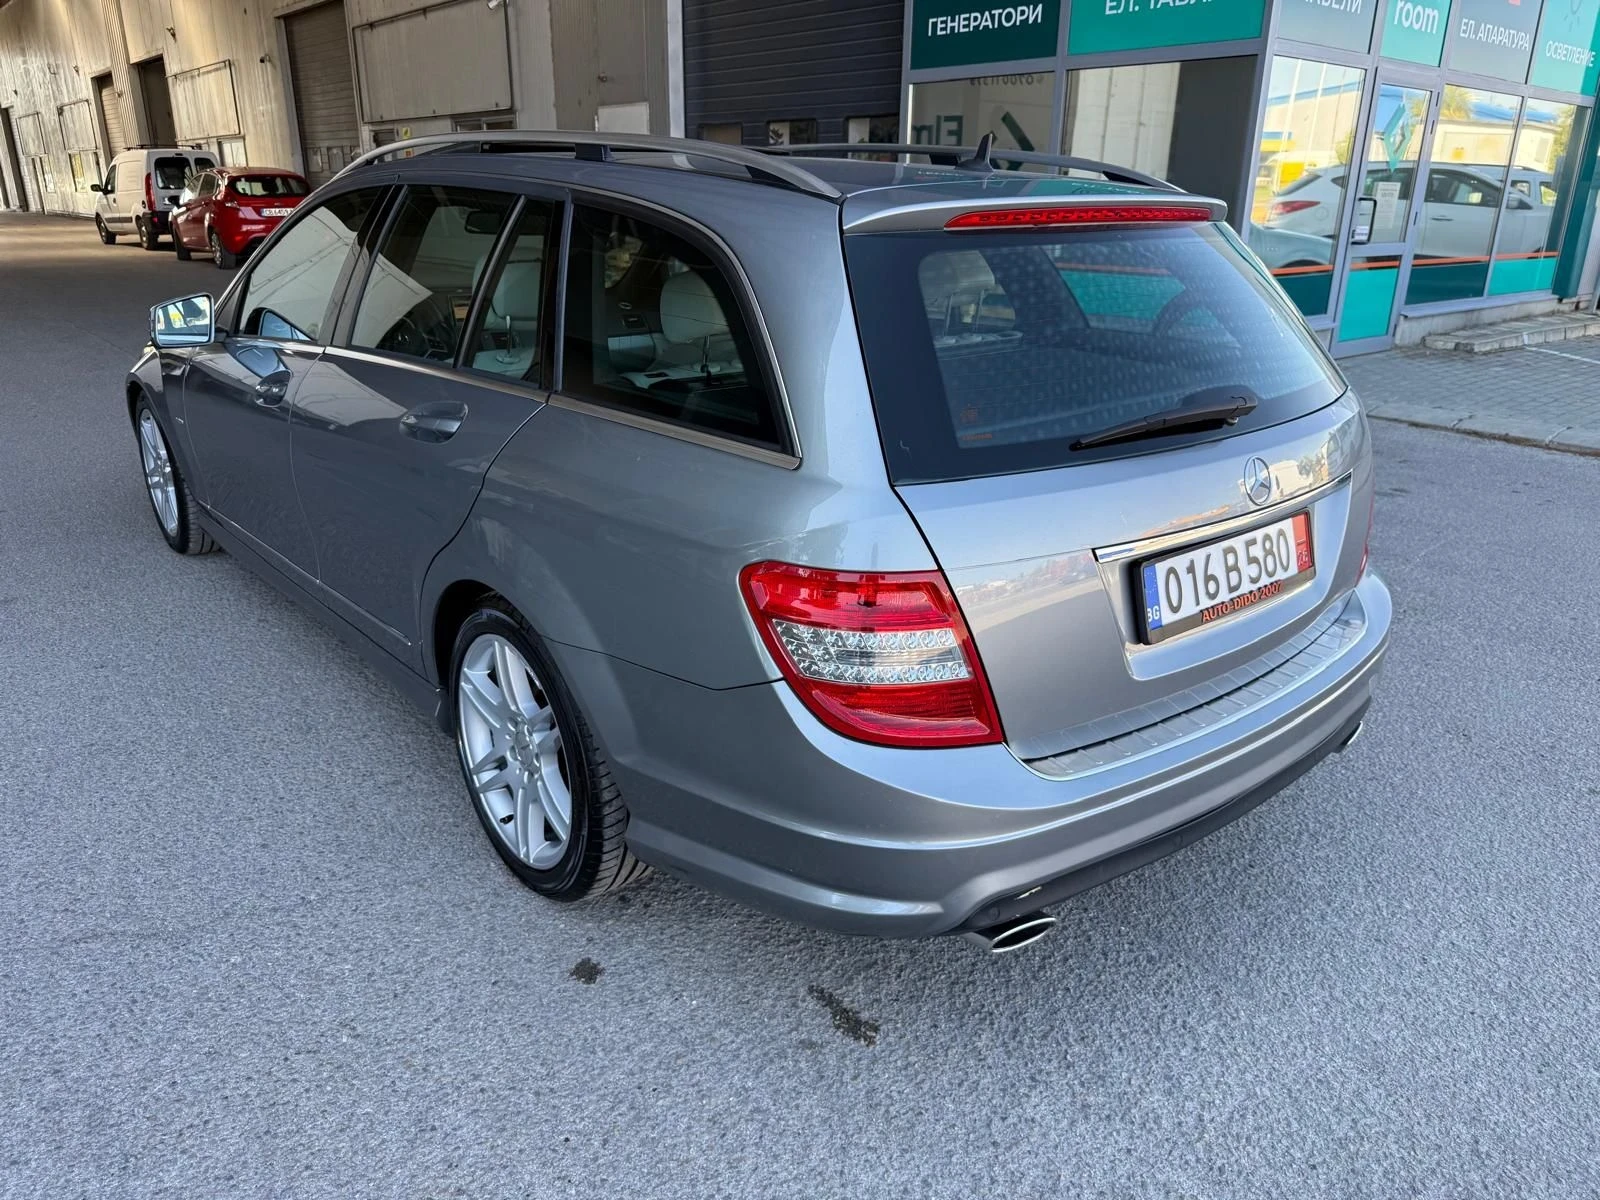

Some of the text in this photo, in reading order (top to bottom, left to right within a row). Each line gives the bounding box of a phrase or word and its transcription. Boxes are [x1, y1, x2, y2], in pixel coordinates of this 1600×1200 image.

[927, 3, 1044, 37] ГЕНЕРАТОРИ
[1394, 0, 1439, 34] room
[1459, 18, 1531, 52] ЕЛ. АПАРАТУРА
[1545, 40, 1597, 67] ОСВЕТЛЕНИЕ
[1164, 528, 1290, 614] 016B580
[1200, 590, 1259, 623] AUTO-DIDO
